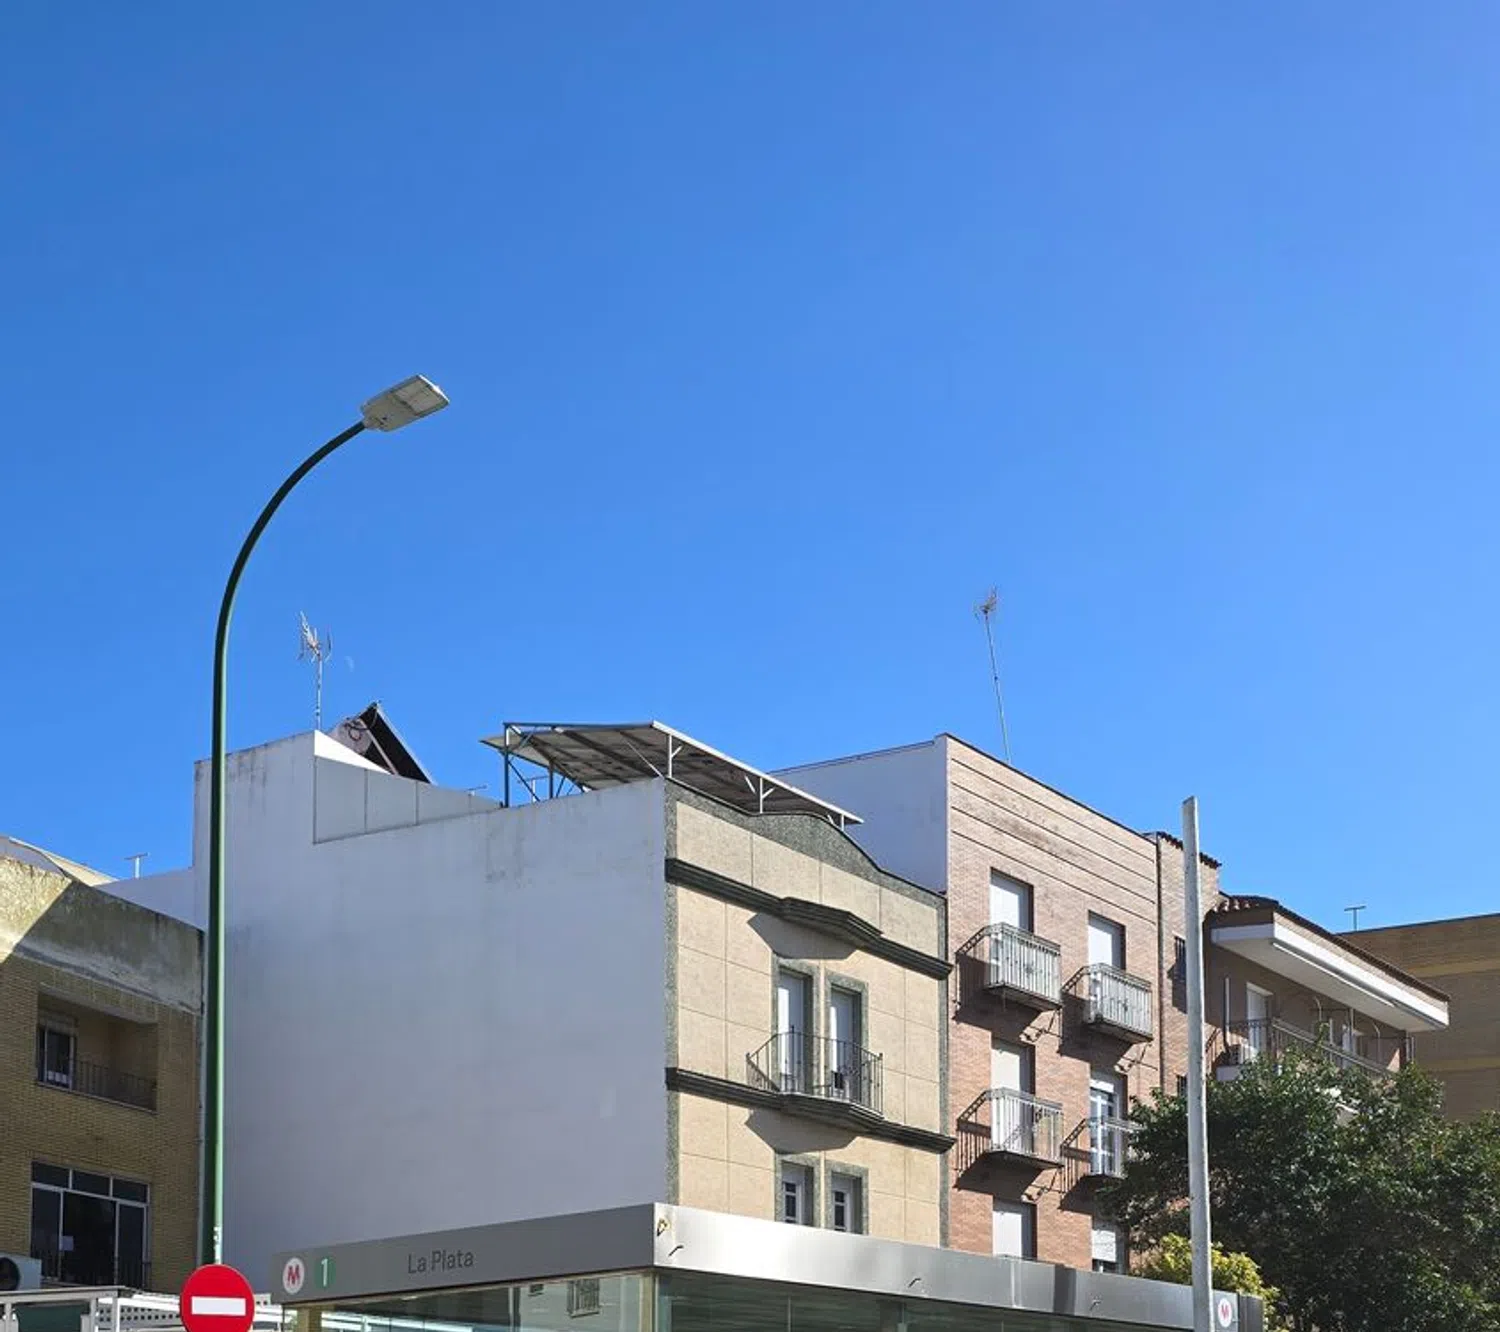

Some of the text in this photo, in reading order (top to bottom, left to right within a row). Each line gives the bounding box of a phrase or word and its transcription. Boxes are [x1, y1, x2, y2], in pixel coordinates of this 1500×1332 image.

[320, 1257, 329, 1287] 1
[408, 1254, 427, 1274] La
[430, 1249, 475, 1272] Plata
